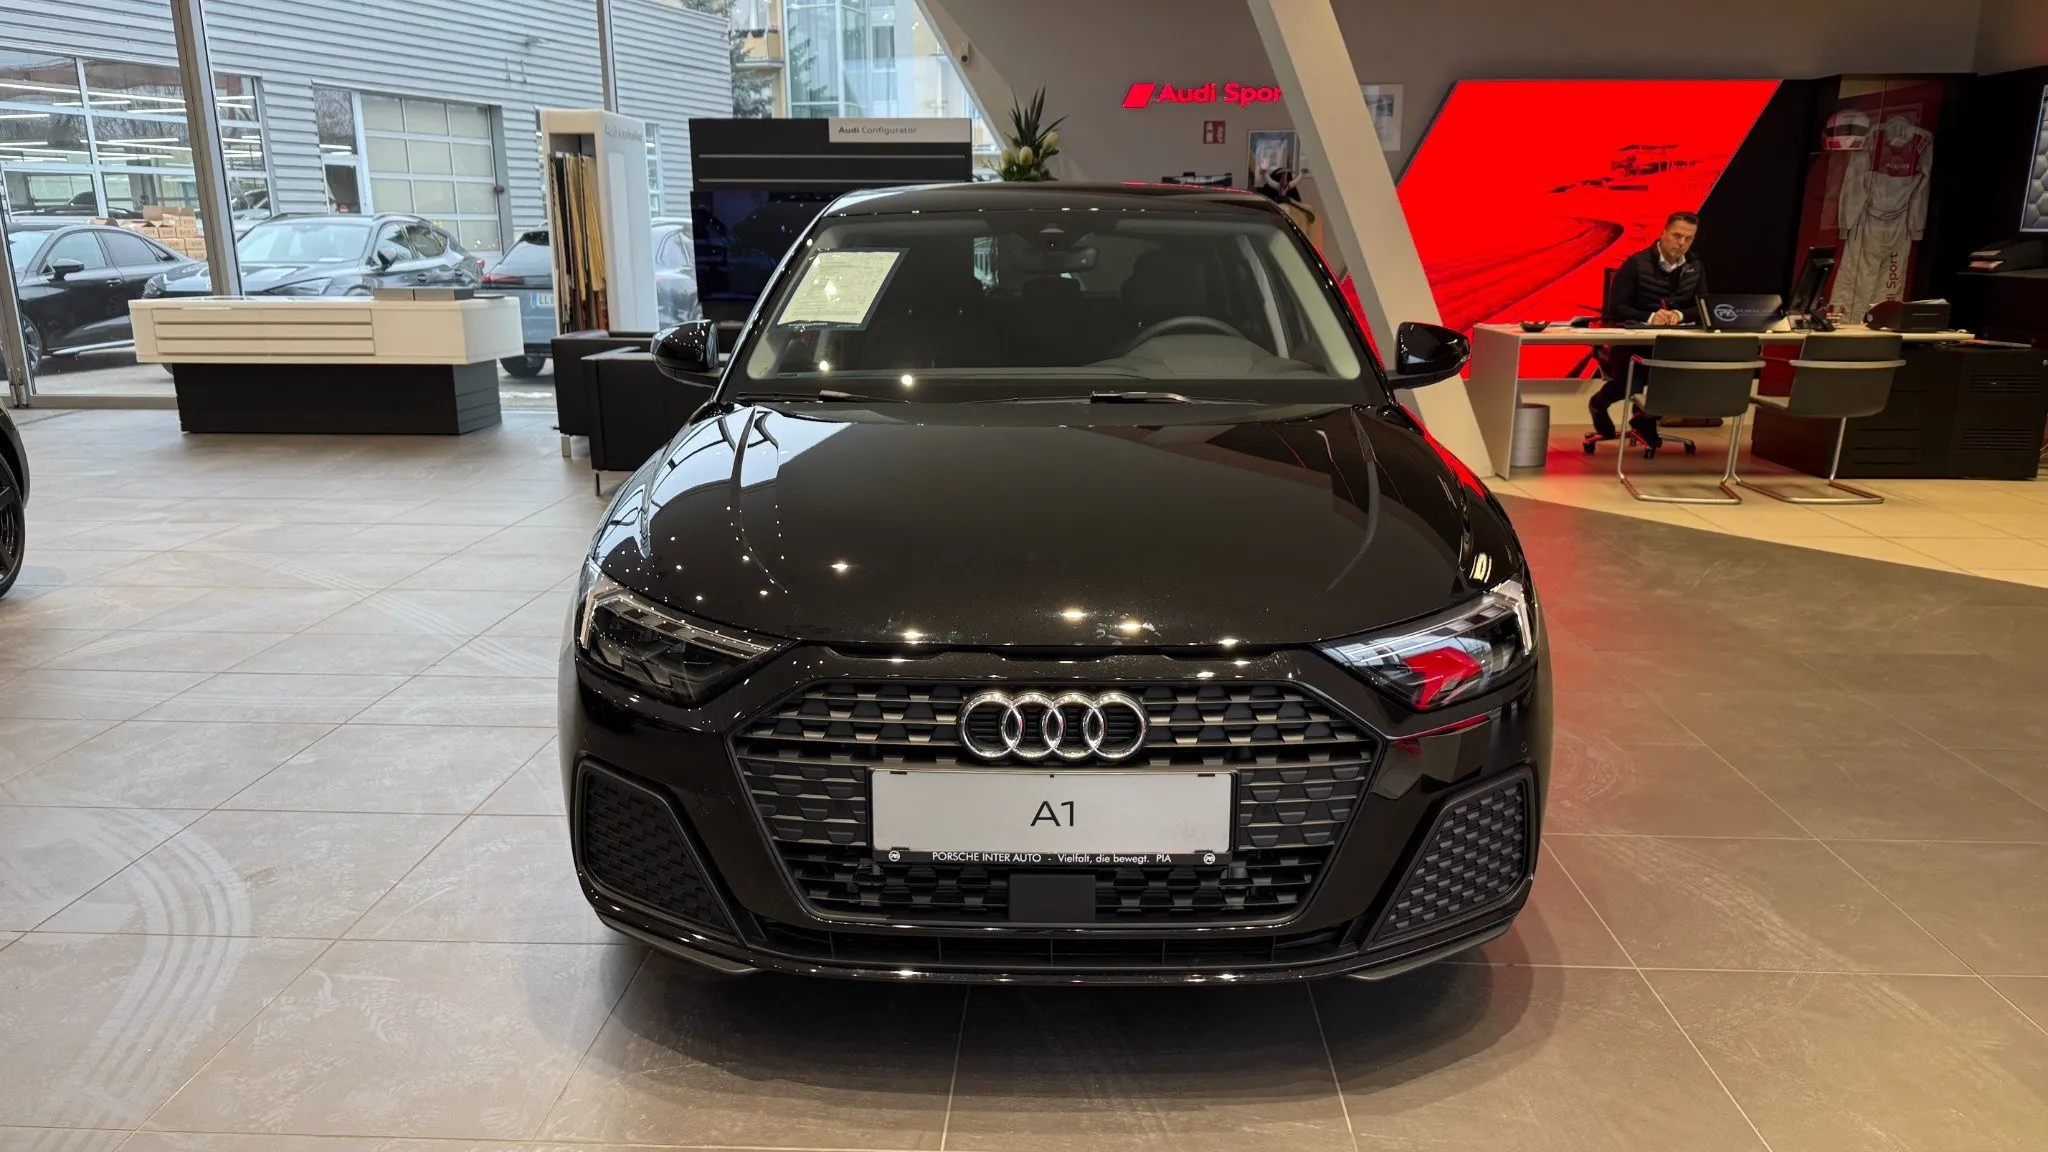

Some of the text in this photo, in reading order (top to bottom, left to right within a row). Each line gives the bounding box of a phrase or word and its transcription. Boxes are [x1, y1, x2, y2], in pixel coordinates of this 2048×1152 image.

[1157, 82, 1282, 107] Audi Spor
[838, 126, 917, 135] Audi Configurator
[1886, 252, 1898, 289] Sport
[1030, 800, 1074, 827] A1
[932, 851, 979, 862] PORSCHE
[983, 852, 1010, 862] INTER
[1013, 852, 1042, 863] AUTO
[1057, 853, 1092, 864] Vielfalt,
[1095, 853, 1111, 863] die
[1113, 854, 1150, 865] bewegt.
[1156, 854, 1172, 863] PIA
